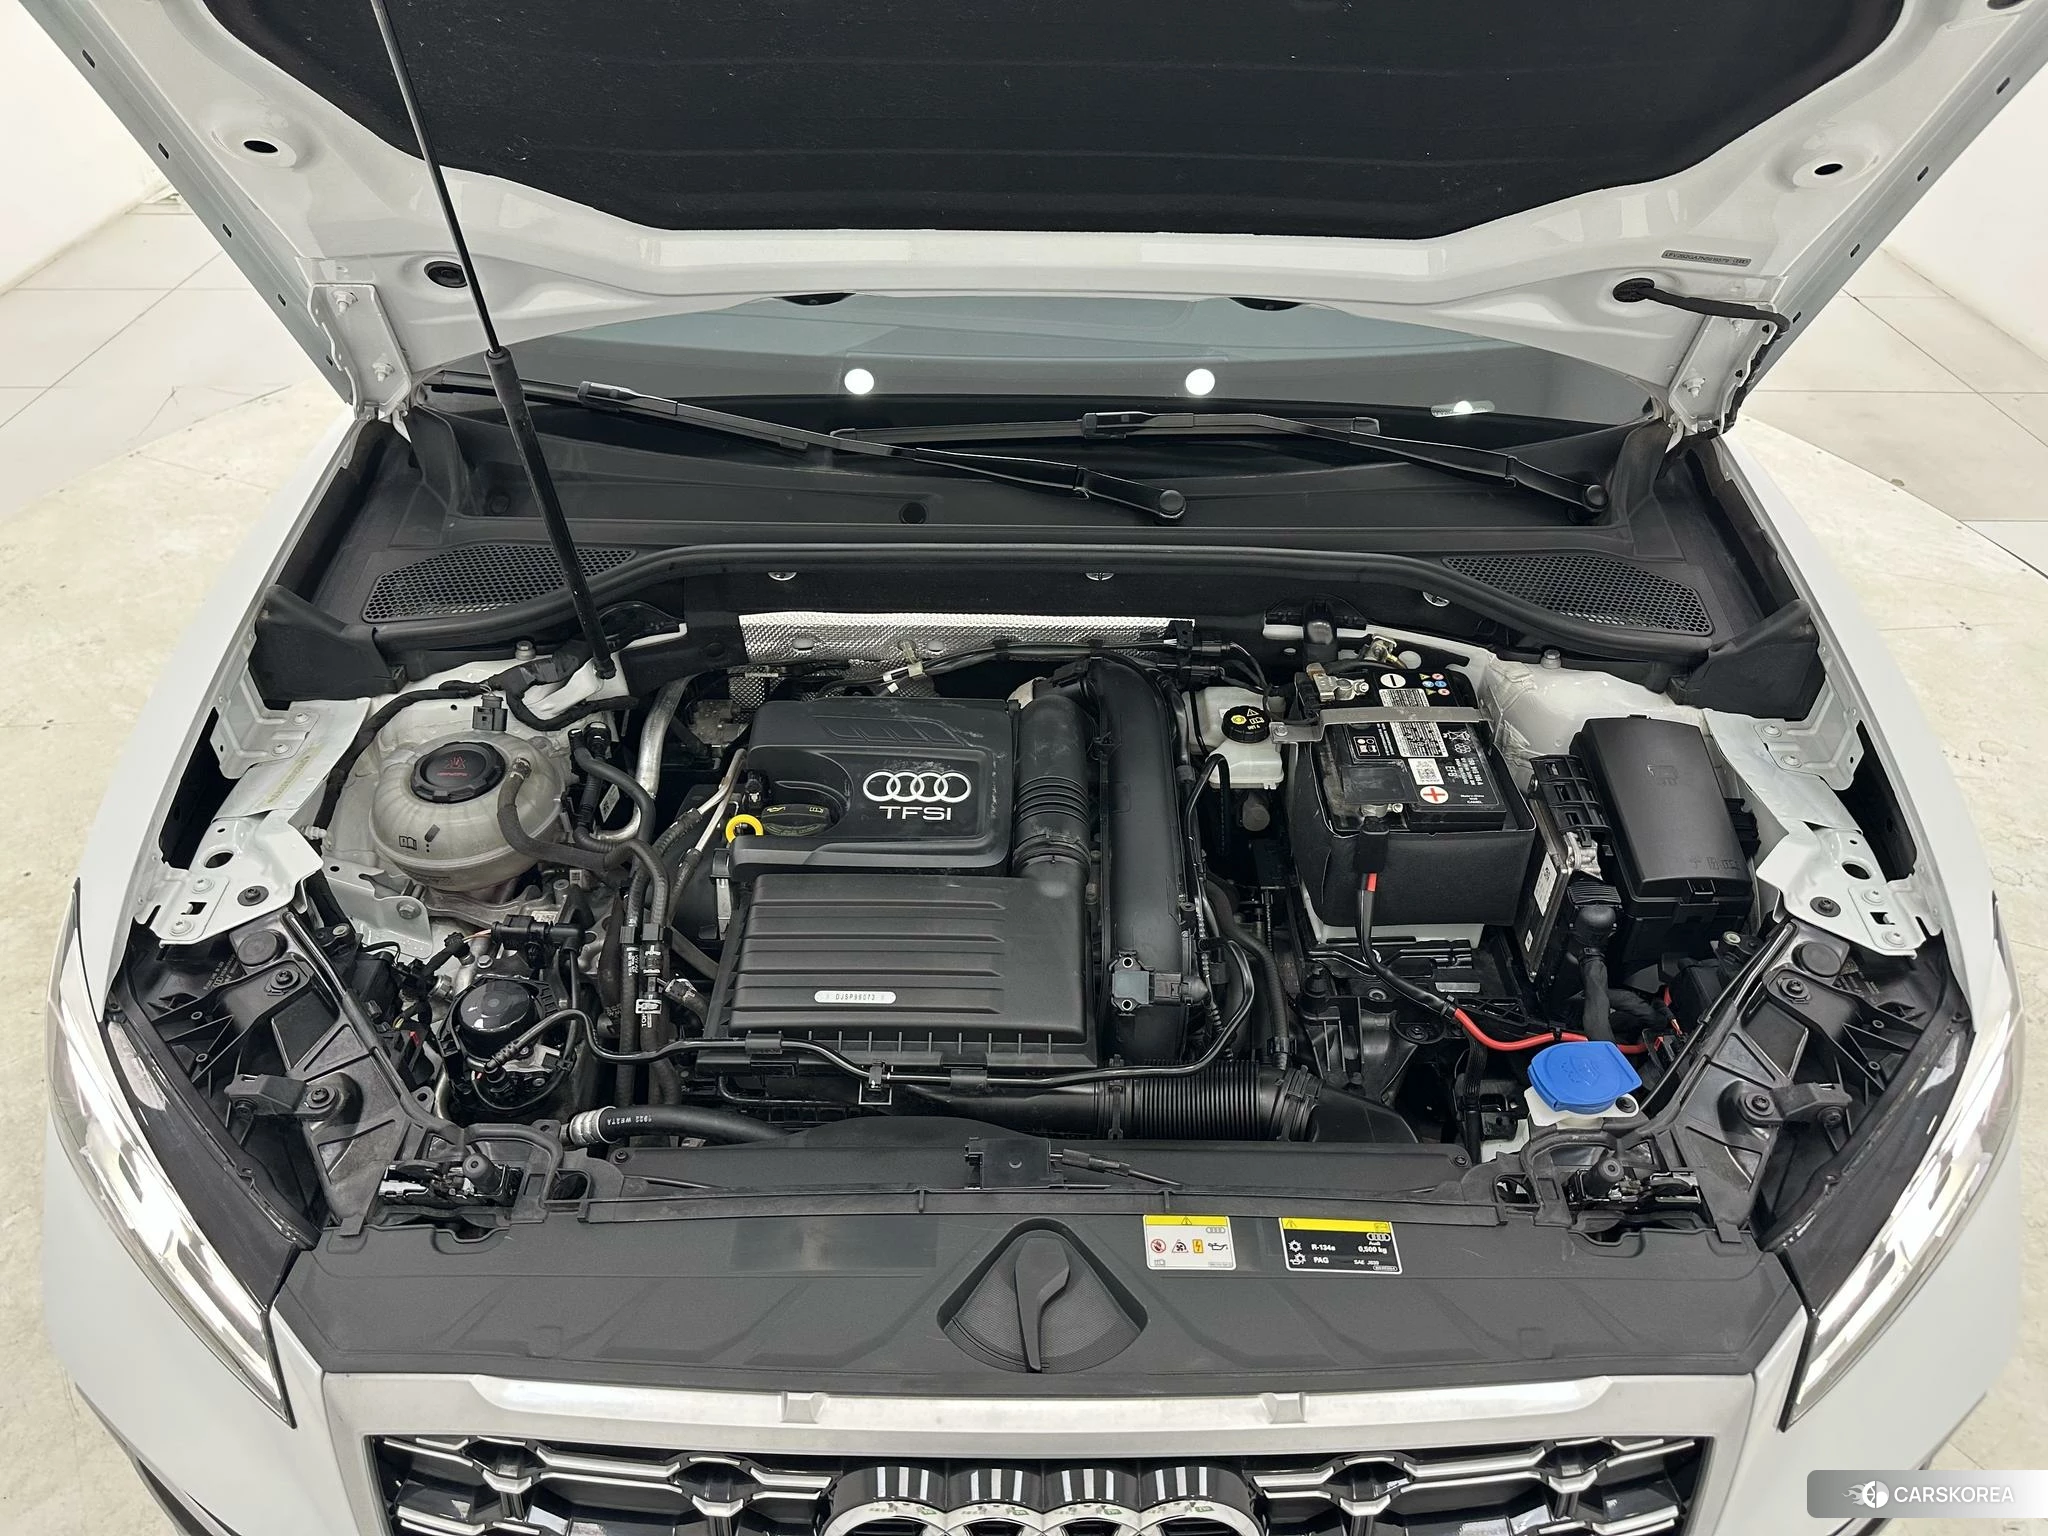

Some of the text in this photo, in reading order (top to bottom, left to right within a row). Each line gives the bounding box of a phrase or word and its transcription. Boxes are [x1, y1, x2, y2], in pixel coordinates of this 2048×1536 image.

[1444, 765, 1458, 777] EFB
[879, 805, 952, 821] TFSI
[1311, 1243, 1336, 1252] R-134a
[1379, 1246, 1388, 1255] kg
[1313, 1256, 1330, 1264] PAG
